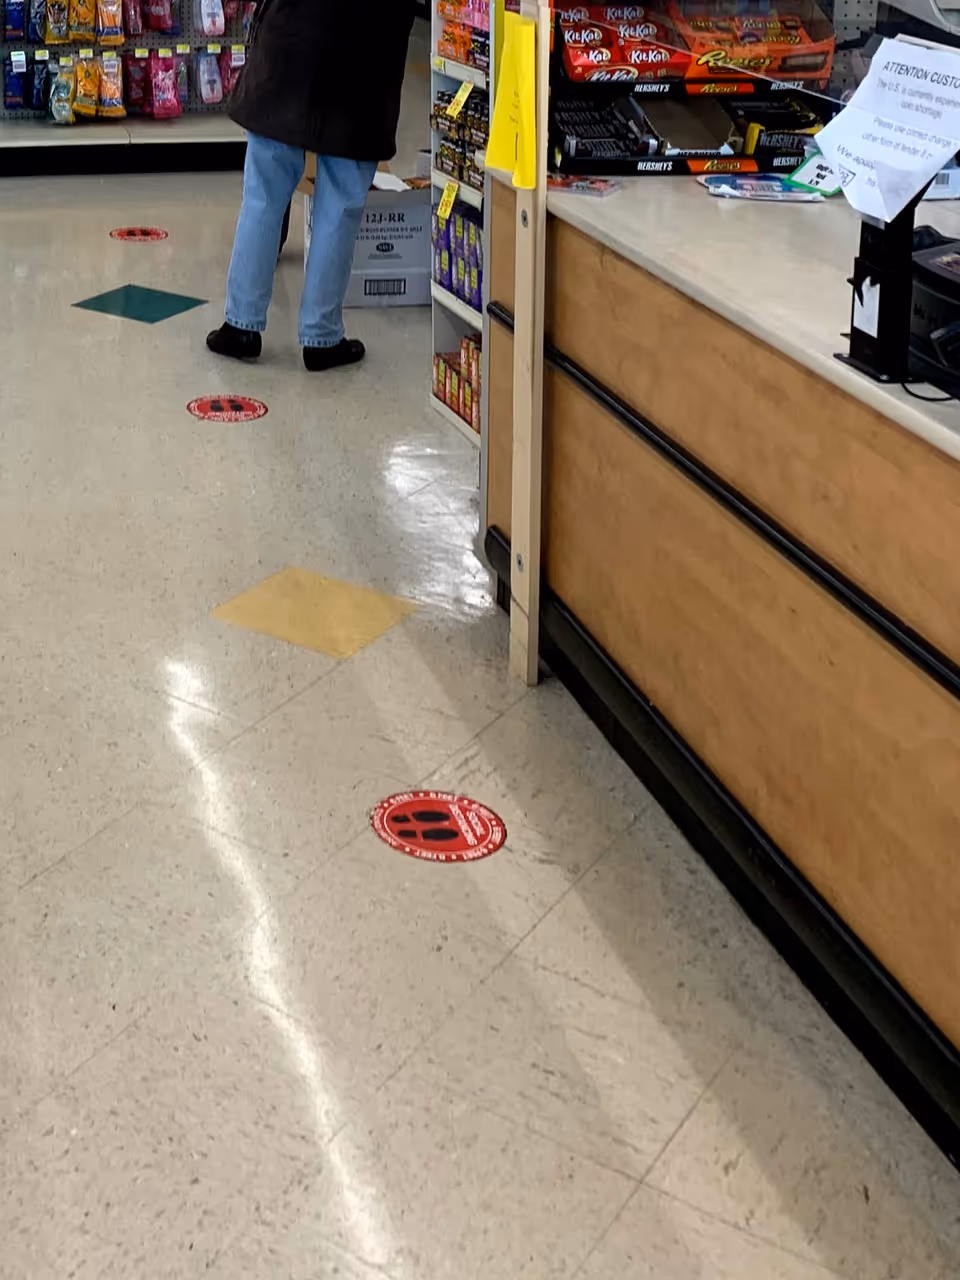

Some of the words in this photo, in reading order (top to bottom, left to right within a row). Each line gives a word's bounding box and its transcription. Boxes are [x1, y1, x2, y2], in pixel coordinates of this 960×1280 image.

[882, 61, 930, 81] ATTENTION
[634, 83, 670, 92] HERSHEY'S
[700, 84, 738, 93] Reese's
[637, 161, 673, 171] HERSHEY'S
[703, 160, 742, 170] Reese's
